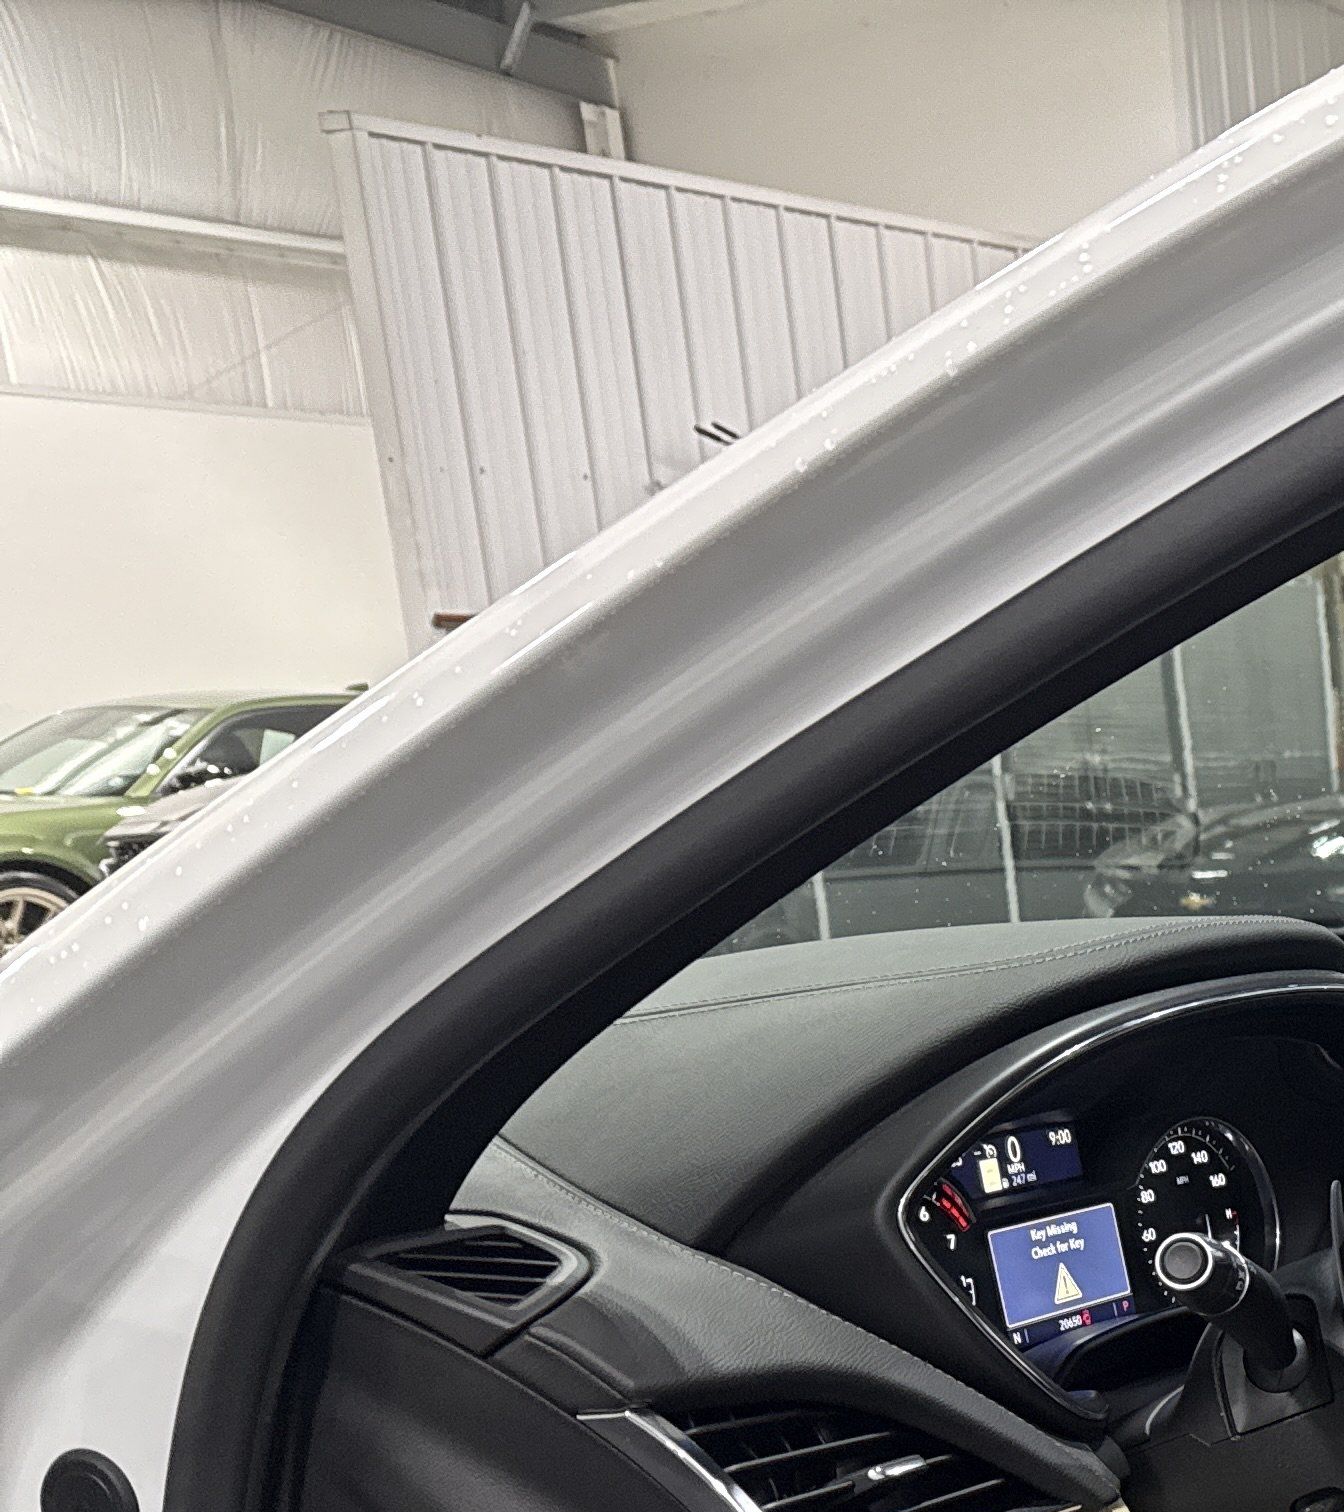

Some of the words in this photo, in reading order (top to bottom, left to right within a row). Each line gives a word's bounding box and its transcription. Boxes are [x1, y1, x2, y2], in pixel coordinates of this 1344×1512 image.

[1048, 1128, 1072, 1146] 9:00
[1007, 1135, 1021, 1163] 0
[1168, 1140, 1185, 1154] 120
[1191, 1150, 1209, 1165] 140
[1007, 1162, 1026, 1175] MPH
[1149, 1159, 1167, 1174] 100
[1209, 1173, 1226, 1188] 160
[1140, 1189, 1155, 1204] 80
[919, 1205, 930, 1222] 6
[1030, 1228, 1046, 1242] Key
[1046, 1221, 1078, 1237] Missing
[1142, 1228, 1156, 1242] 60
[945, 1233, 957, 1251] 7
[1031, 1243, 1056, 1259] Check
[1056, 1241, 1068, 1254] for
[1069, 1237, 1085, 1251] Key
[1121, 1299, 1130, 1312] P
[1012, 1330, 1022, 1344] N
